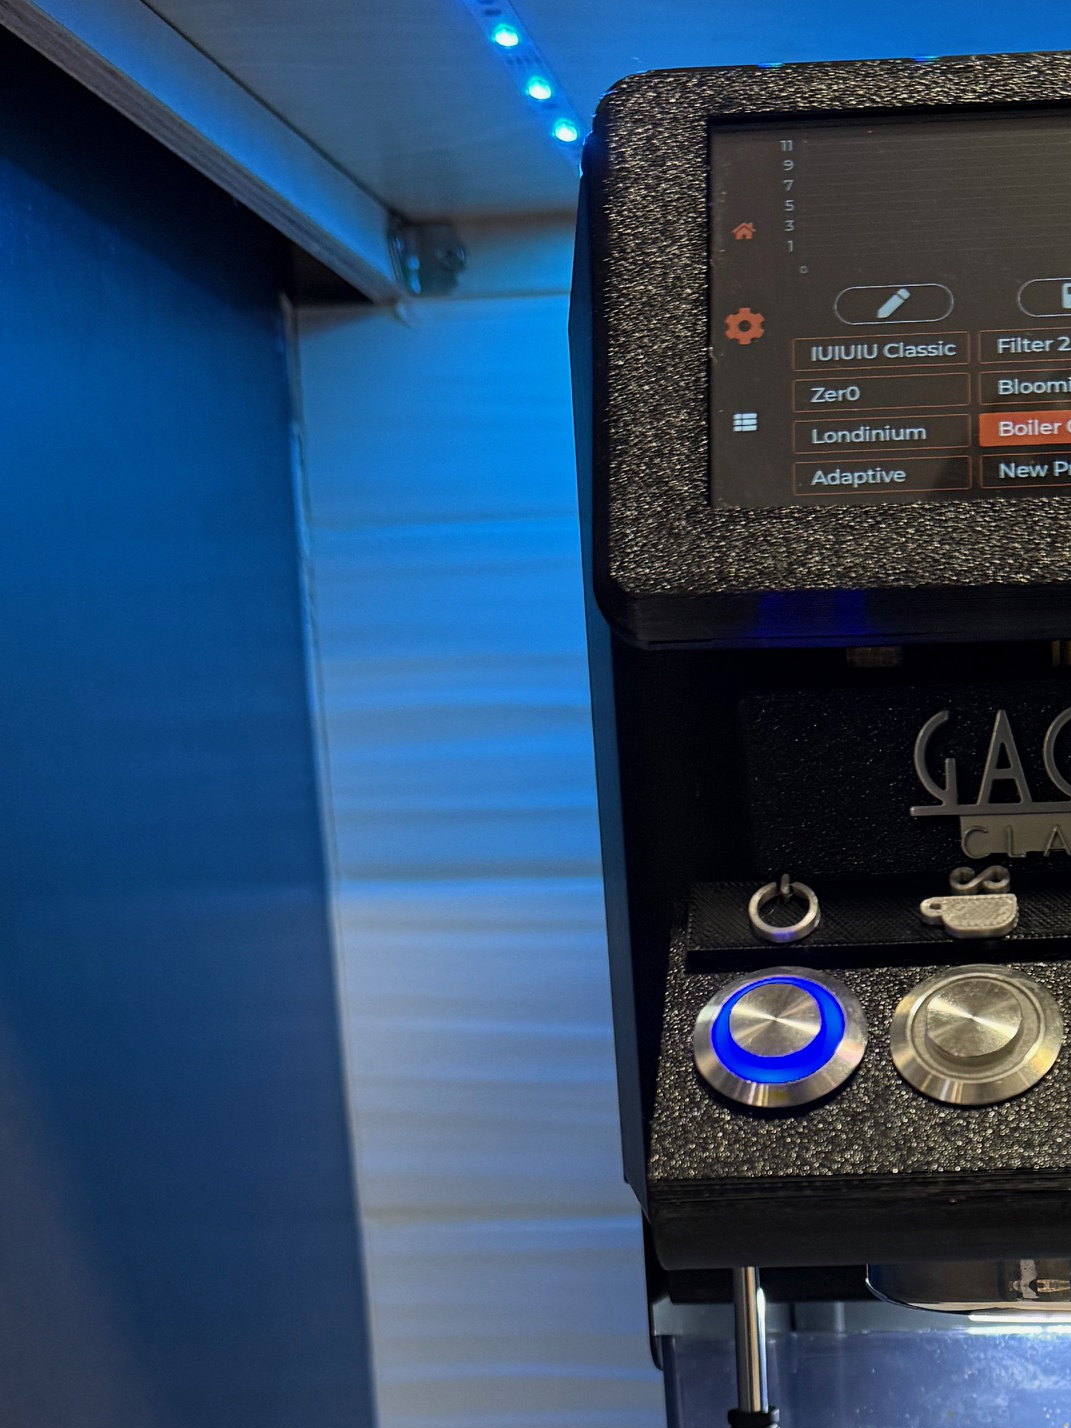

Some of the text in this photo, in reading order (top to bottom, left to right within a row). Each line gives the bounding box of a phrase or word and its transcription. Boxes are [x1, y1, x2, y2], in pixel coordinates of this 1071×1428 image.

[779, 140, 794, 152] 11
[783, 159, 794, 171] 9
[783, 179, 794, 191] 7
[784, 200, 795, 212] 5
[784, 220, 795, 232] 3
[787, 240, 794, 252] 1
[883, 341, 957, 359] Classic
[997, 337, 1053, 354] Filter
[811, 425, 927, 445] Londinium
[998, 419, 1062, 437] Boiler
[999, 460, 1048, 478] New
[811, 466, 906, 488] Adaptive
